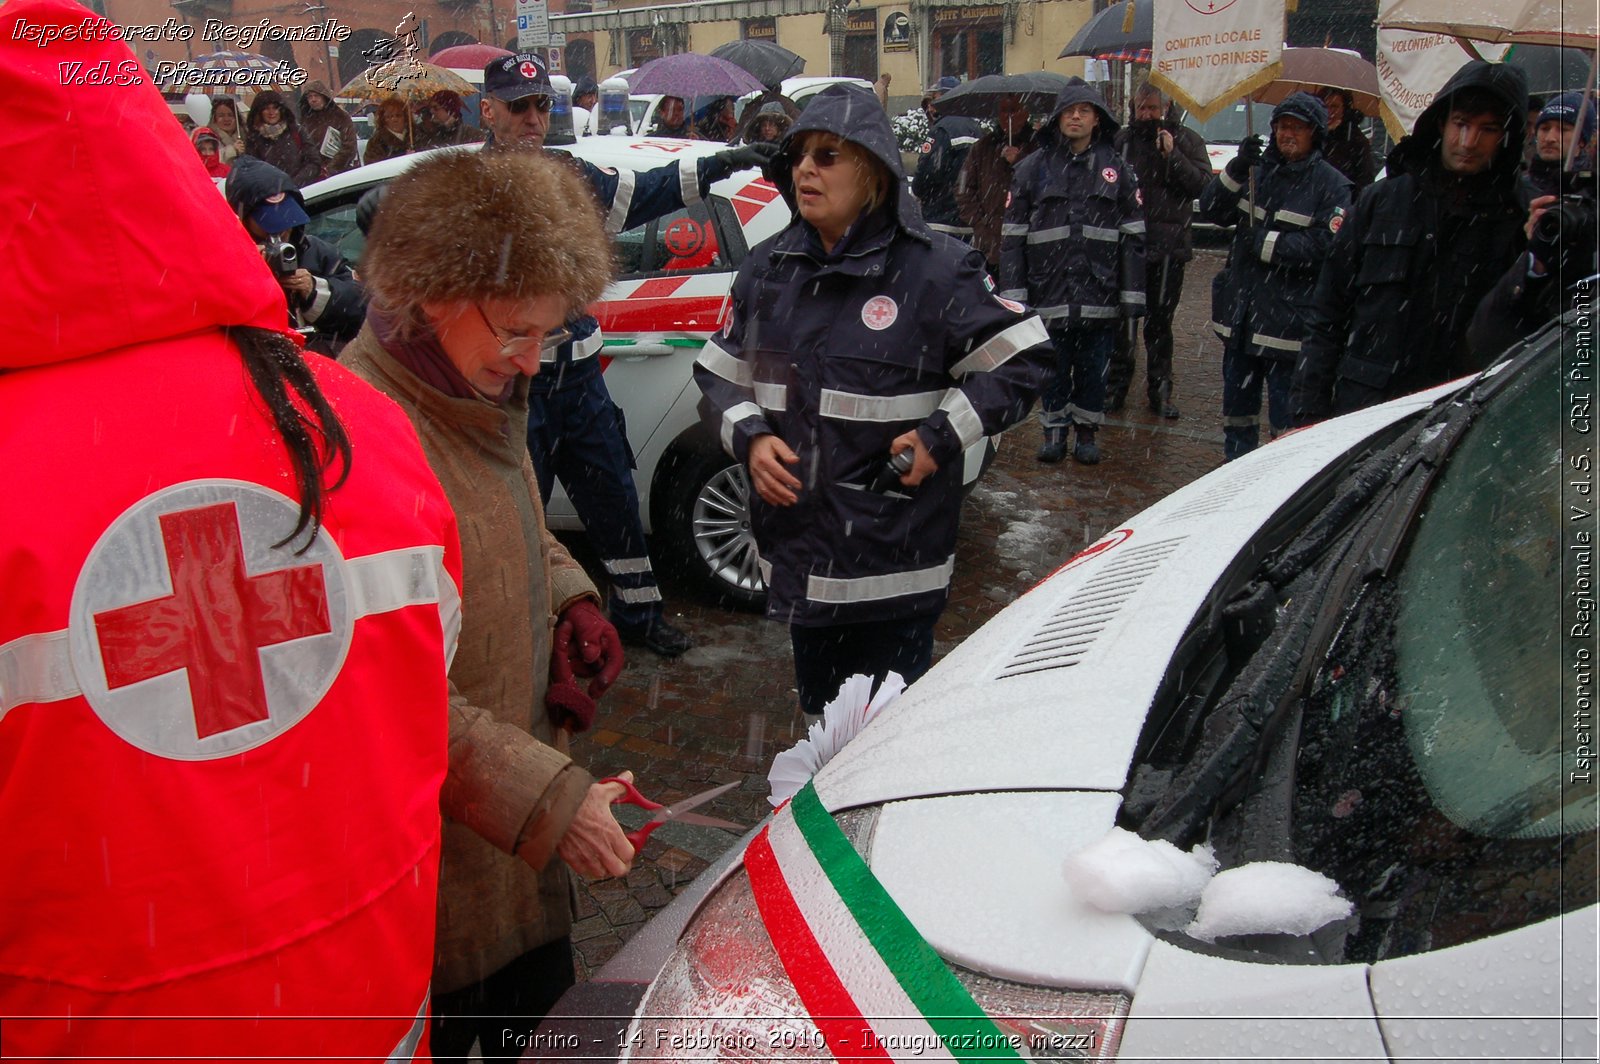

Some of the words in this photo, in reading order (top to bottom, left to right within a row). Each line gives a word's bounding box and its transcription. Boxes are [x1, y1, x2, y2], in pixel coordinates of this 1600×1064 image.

[1165, 34, 1211, 51] COMITATO
[1215, 29, 1262, 44] LOCALE
[1158, 55, 1203, 72] SETTIMO
[1206, 50, 1269, 66] TORINESE
[1377, 50, 1393, 80] SAN
[1386, 77, 1434, 109] FRANCESC
